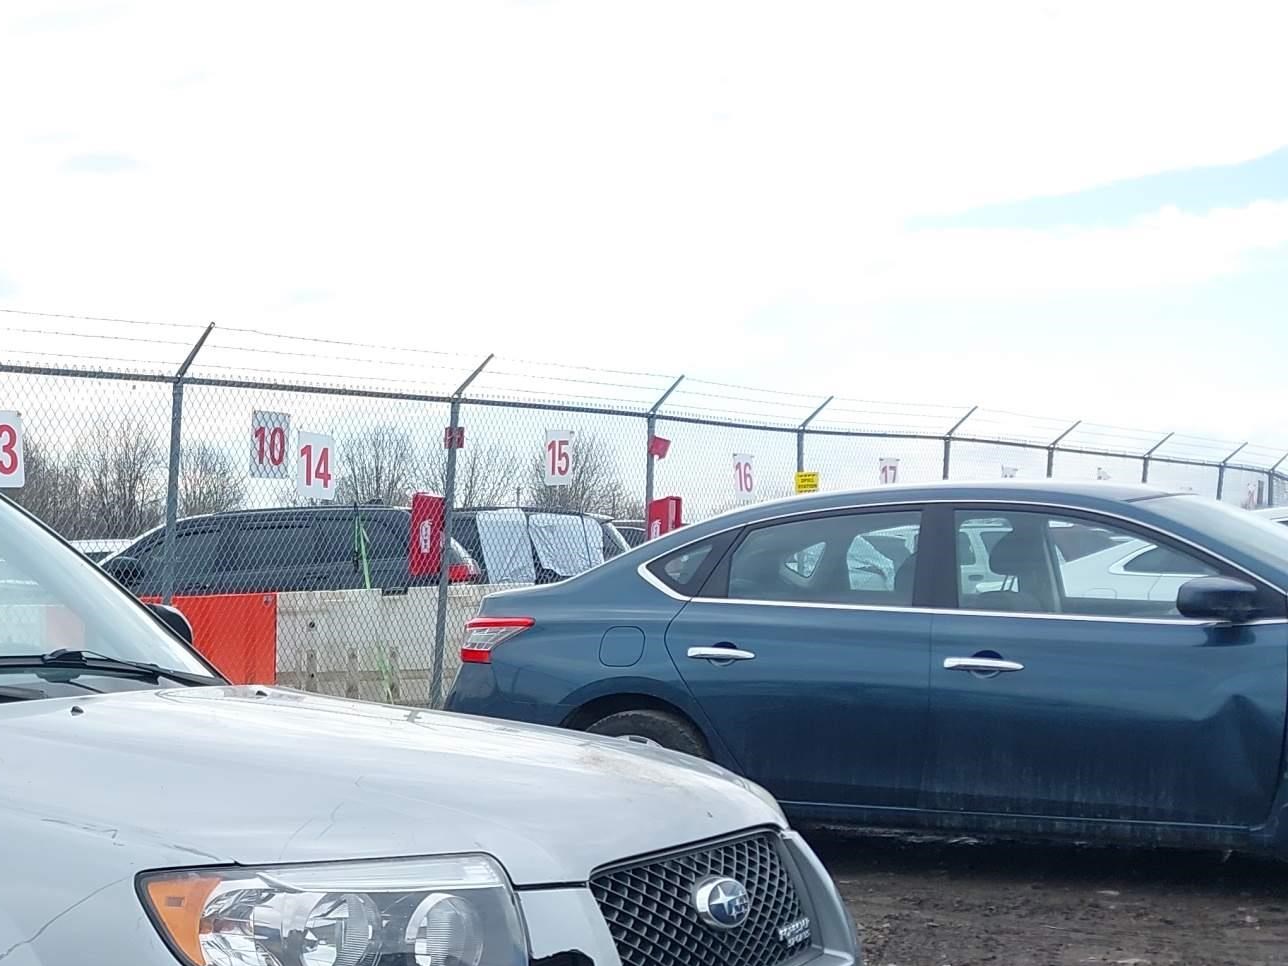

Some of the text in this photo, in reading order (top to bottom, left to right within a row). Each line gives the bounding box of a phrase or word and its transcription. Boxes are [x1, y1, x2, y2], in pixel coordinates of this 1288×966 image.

[255, 426, 284, 466] 10
[547, 439, 570, 476] 15
[300, 444, 332, 489] 14
[735, 461, 753, 492] 16
[882, 465, 897, 484] 17
